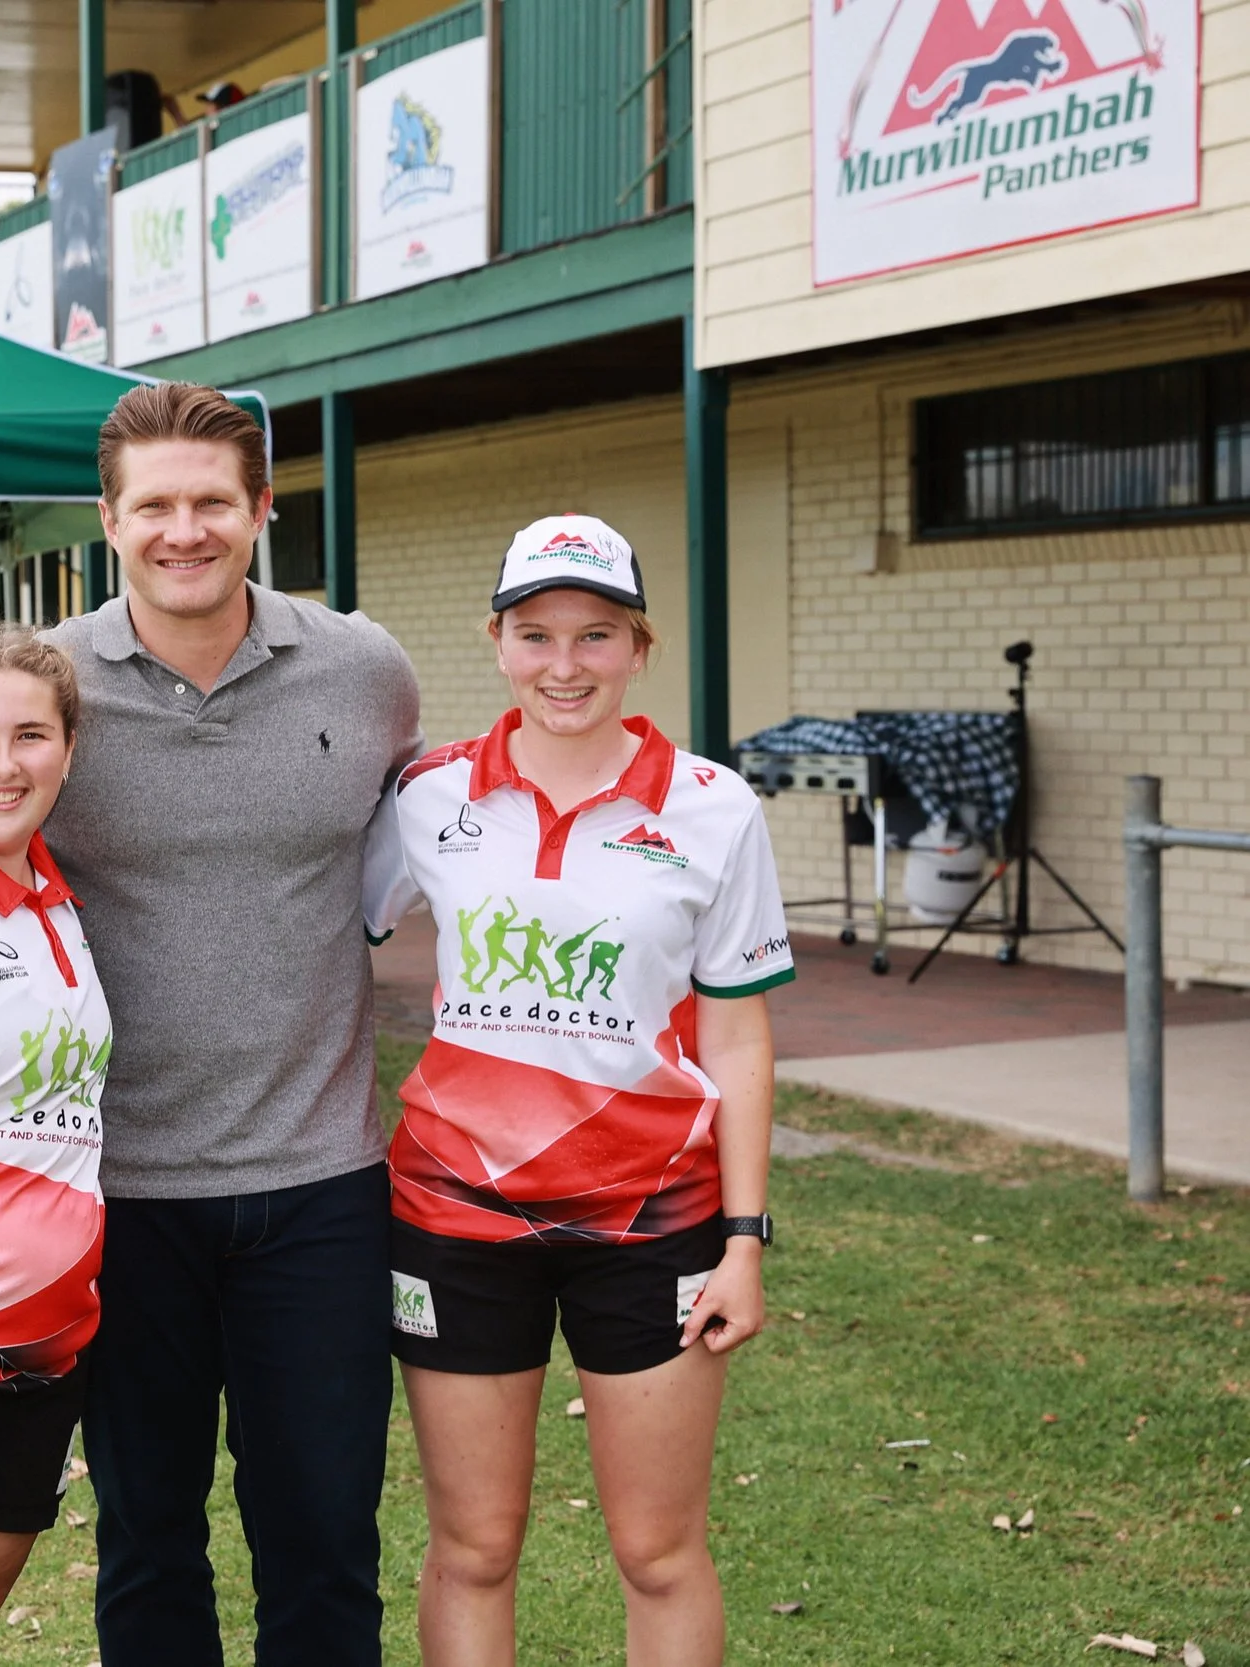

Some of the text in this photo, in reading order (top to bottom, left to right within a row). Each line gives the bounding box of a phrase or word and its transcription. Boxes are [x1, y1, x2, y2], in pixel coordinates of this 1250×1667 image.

[837, 71, 1154, 198] Murwillumbah
[983, 135, 1152, 200] Panthers
[601, 841, 689, 863] Murwillumbah
[441, 1001, 635, 1032] pace doctor
[440, 1020, 635, 1046] THE ART AND SCIENCE OF FAST BOWLING
[9, 1130, 33, 1140] AND
[36, 1133, 72, 1144] SCIENCE
